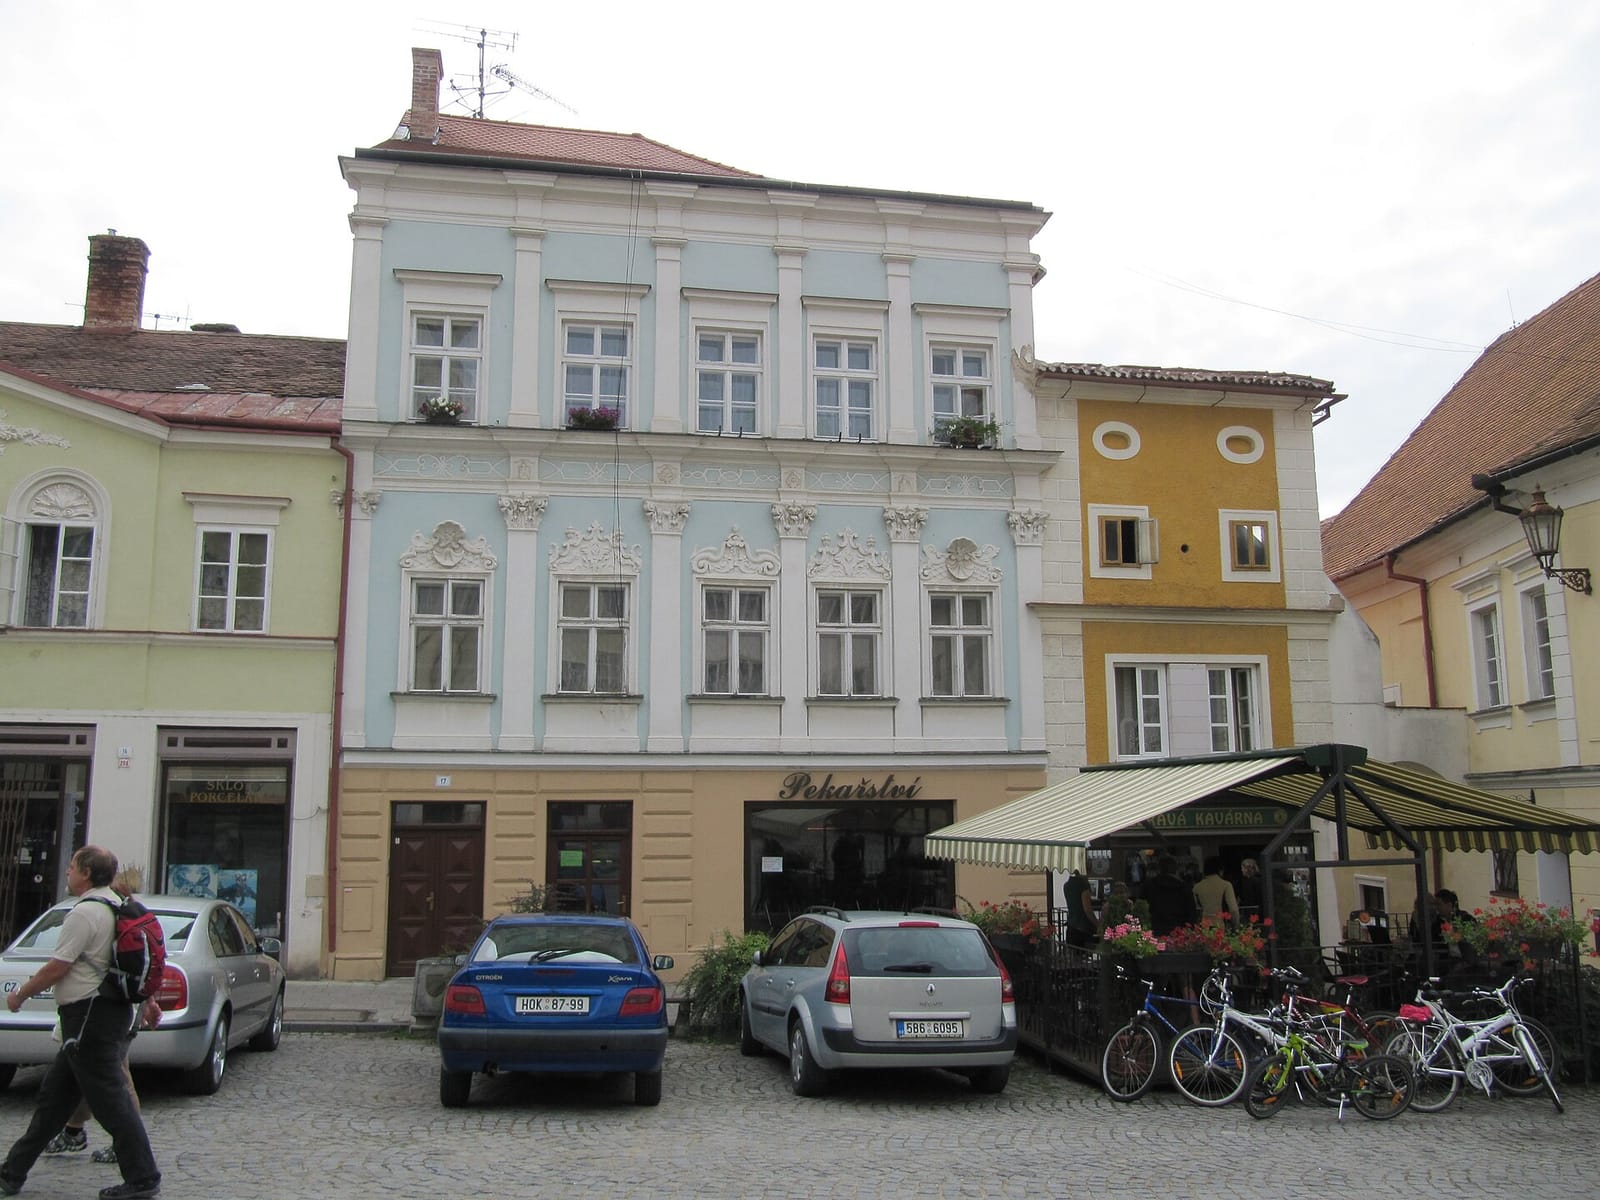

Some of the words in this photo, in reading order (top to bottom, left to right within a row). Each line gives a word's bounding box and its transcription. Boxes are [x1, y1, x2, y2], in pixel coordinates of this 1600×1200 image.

[207, 781, 243, 791] SKLO
[779, 772, 922, 799] Pekařství
[1195, 809, 1263, 825] KAVÁRNA
[521, 998, 542, 1010] HOK
[551, 998, 584, 1010] 87-99
[933, 1022, 958, 1034] 6095
